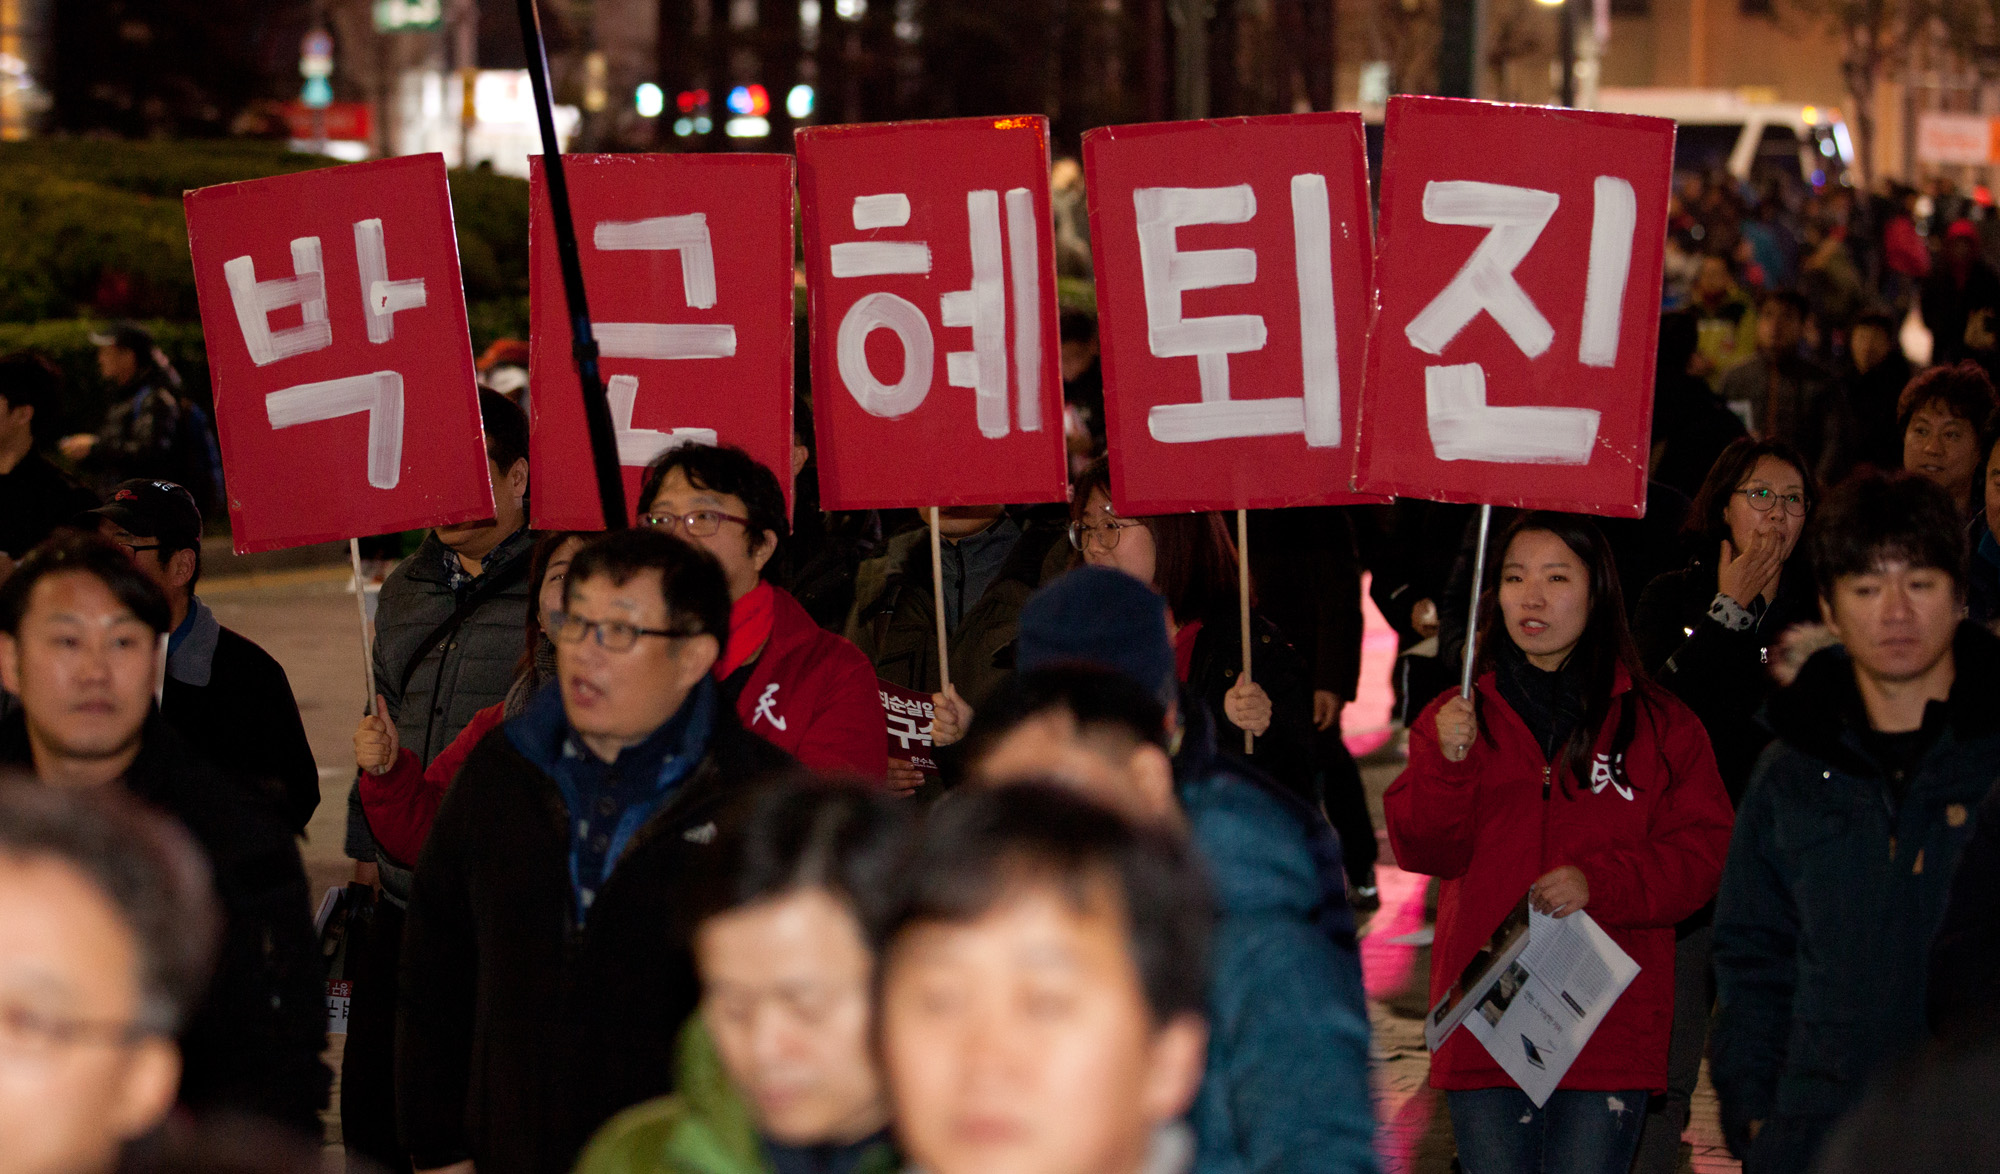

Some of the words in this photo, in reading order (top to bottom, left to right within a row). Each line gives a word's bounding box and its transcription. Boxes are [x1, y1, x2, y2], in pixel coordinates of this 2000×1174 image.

[223, 218, 426, 489] 박
[591, 213, 737, 467] 근
[830, 188, 1042, 439] 혜
[1133, 173, 1342, 448] 퇴
[1405, 175, 1636, 466] 진
